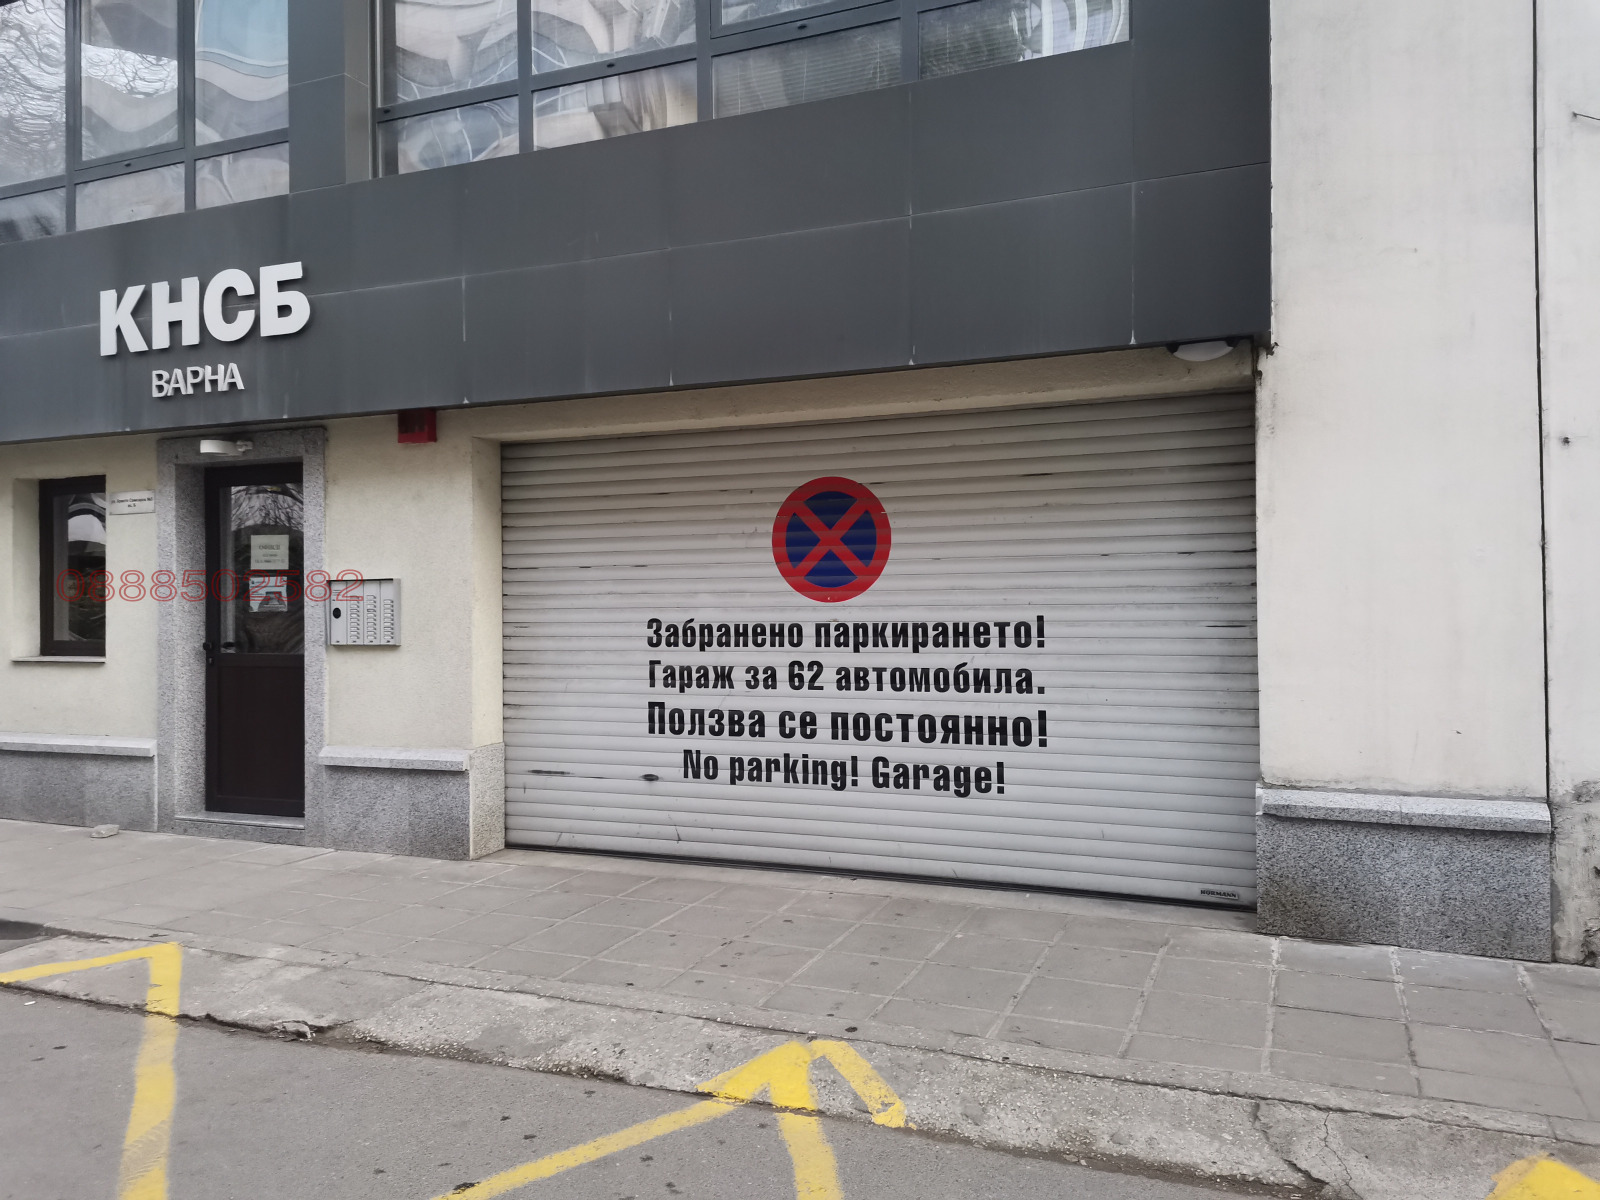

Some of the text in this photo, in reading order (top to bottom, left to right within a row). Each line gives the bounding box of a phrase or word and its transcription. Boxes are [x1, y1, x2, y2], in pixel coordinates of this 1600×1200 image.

[100, 262, 310, 356] КНСБ
[152, 363, 244, 397] ВАРНА
[647, 616, 1044, 653] Забранено паркирането!
[649, 660, 1044, 694] Гараж за 62 автомобила.
[648, 702, 1047, 747] Ползва се постоянно!
[684, 750, 1004, 798] No parking! Garage!
